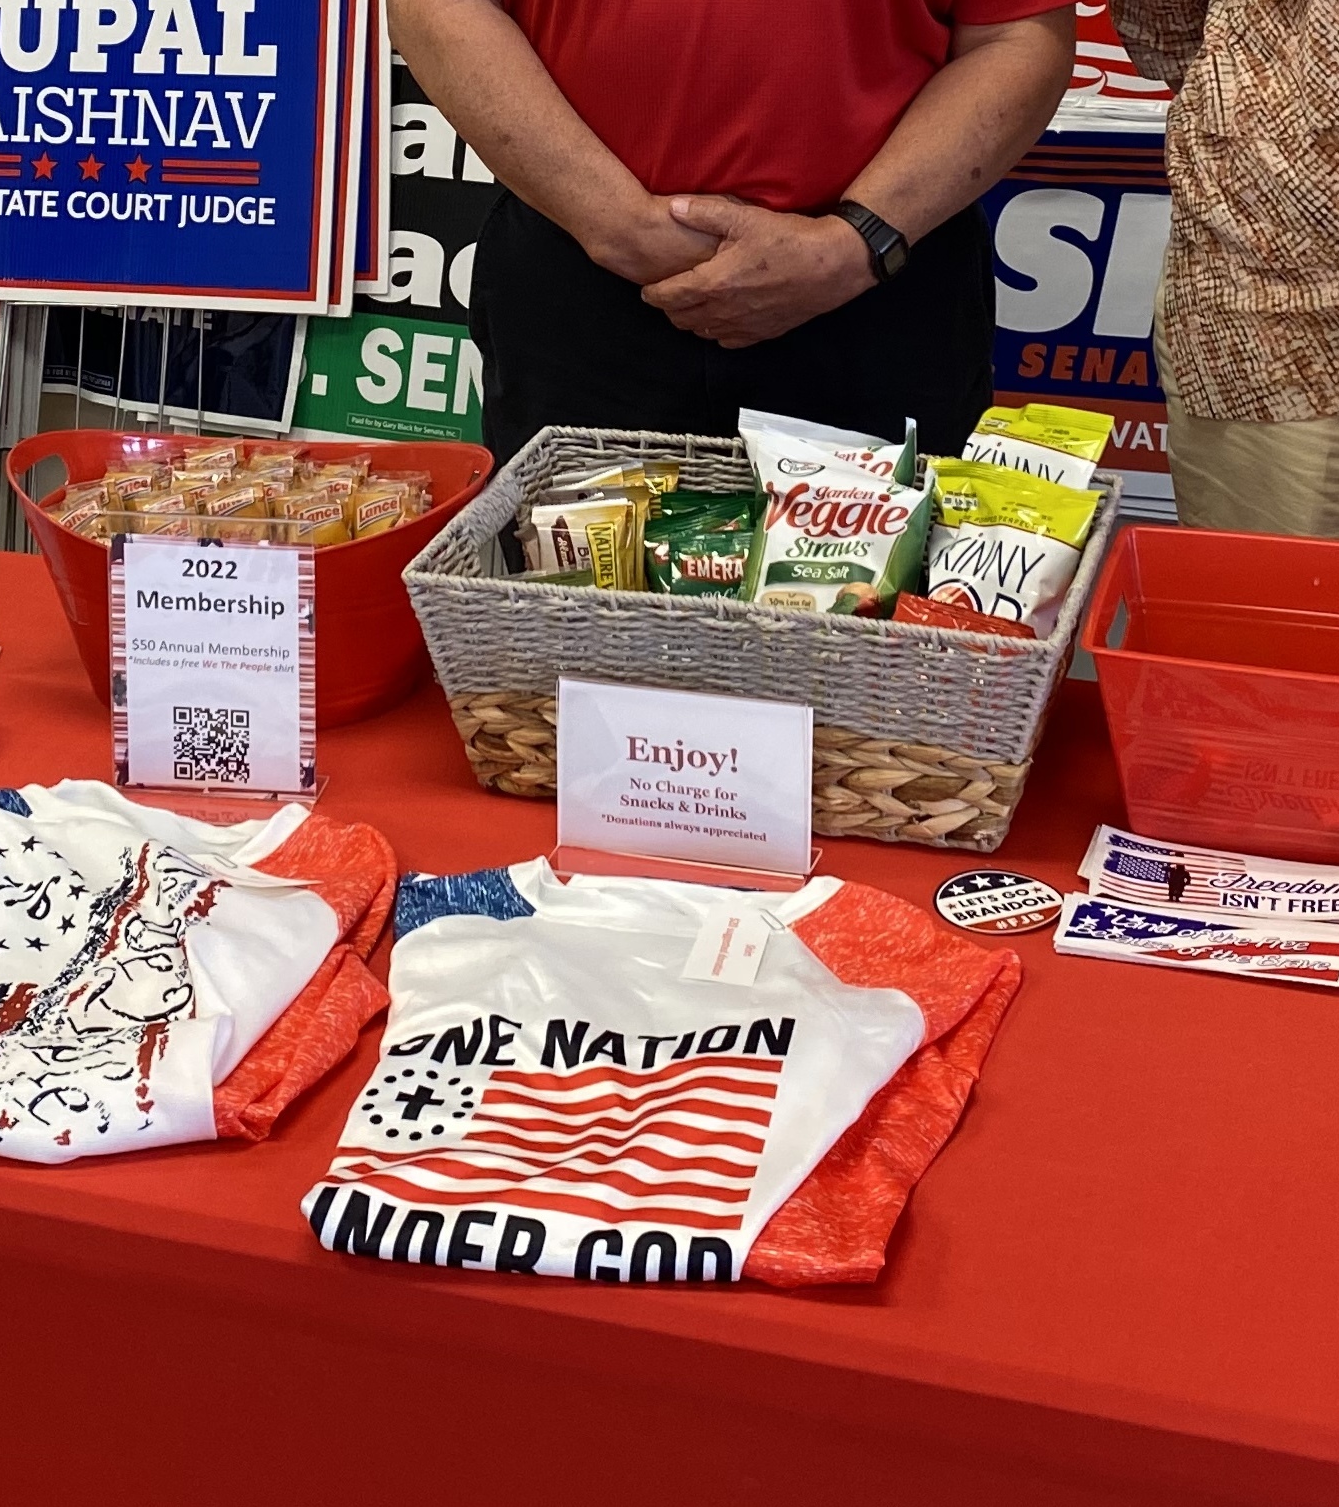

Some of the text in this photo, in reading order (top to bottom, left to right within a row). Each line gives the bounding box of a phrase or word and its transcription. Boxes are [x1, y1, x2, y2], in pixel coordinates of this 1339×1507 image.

[67, 191, 173, 223] COURT
[177, 193, 276, 228] JUDGE
[1017, 342, 1157, 388] SENA
[813, 486, 874, 500] garden
[358, 497, 399, 523] Lance
[763, 481, 909, 538] Veggie
[786, 537, 870, 558] Straws
[182, 558, 238, 580] 2022
[791, 563, 849, 580] Sea Salt
[136, 590, 285, 620] Membership
[132, 638, 290, 659] $50 Annual Membership
[181, 658, 200, 669] free
[202, 660, 218, 669] We
[221, 661, 237, 670] The
[240, 662, 271, 673] People
[274, 664, 294, 674] shirt
[626, 735, 738, 776] Enjoy!
[630, 777, 737, 802] No Charge for
[620, 794, 747, 821] Snacks & Drinks
[664, 819, 701, 833] always
[703, 823, 767, 842] appreciated
[952, 893, 1057, 923] BRANDON
[958, 887, 1030, 910] LET'S GO
[1220, 892, 1277, 913] ISN'T
[995, 911, 1045, 931] #FJB
[1111, 915, 1310, 951] Land of the Free
[1178, 946, 1210, 957] of
[1211, 948, 1252, 963] the
[1258, 953, 1331, 971] Brave
[387, 1014, 796, 1069] ONE NATION
